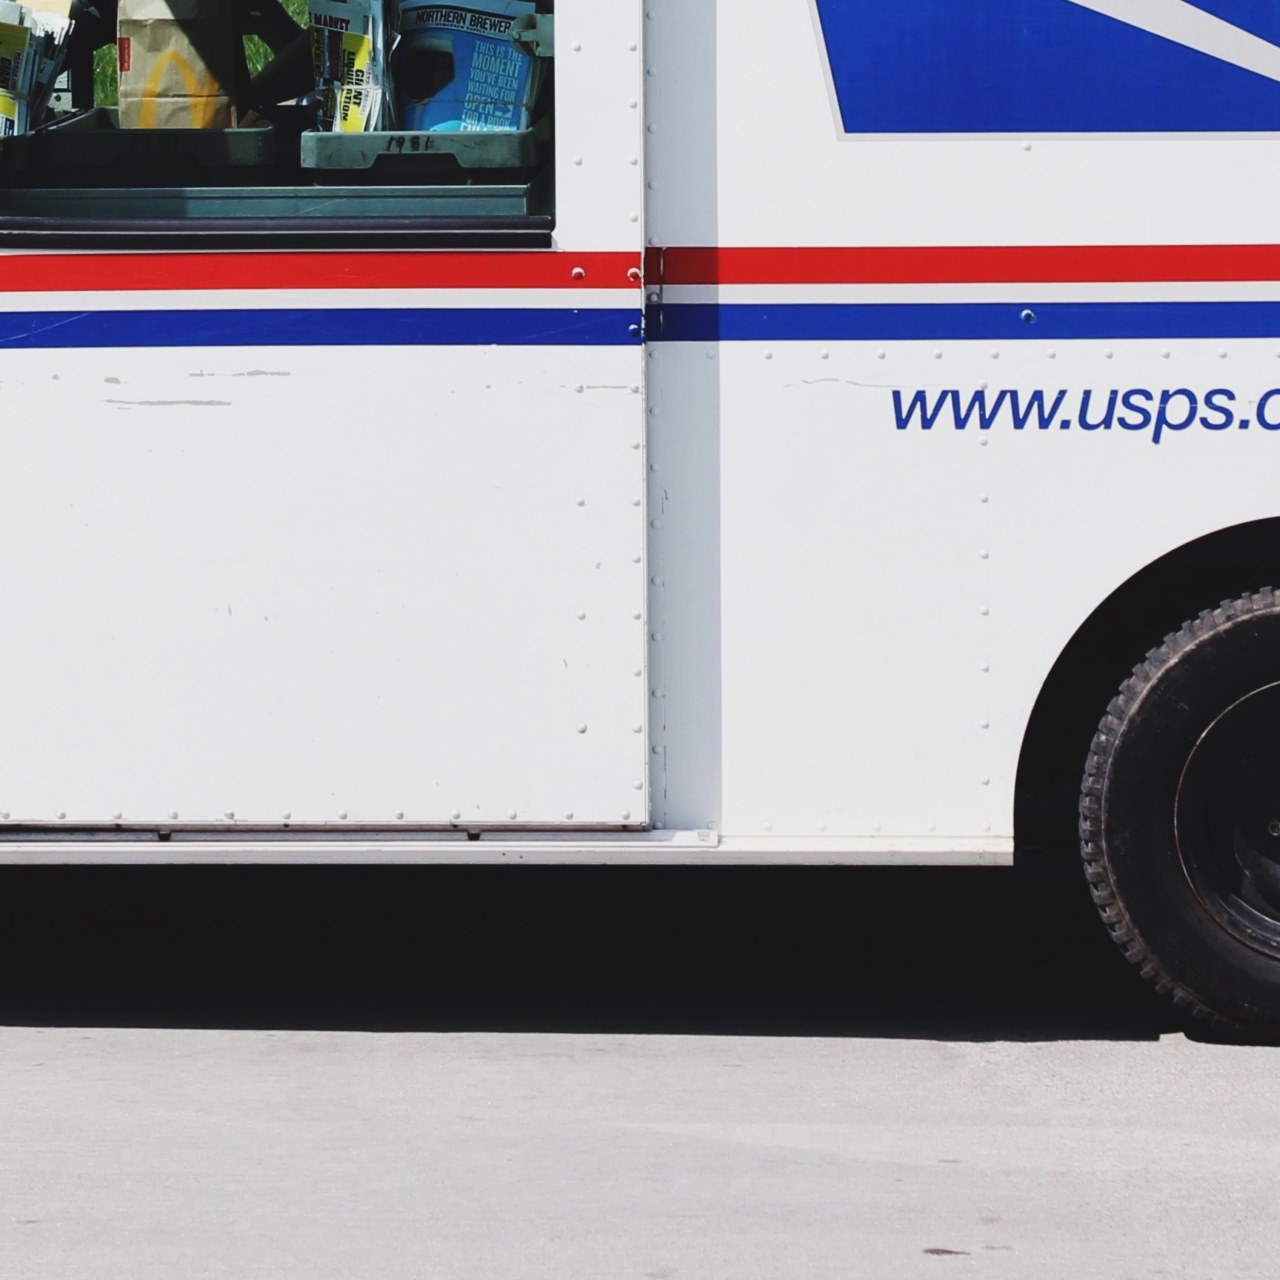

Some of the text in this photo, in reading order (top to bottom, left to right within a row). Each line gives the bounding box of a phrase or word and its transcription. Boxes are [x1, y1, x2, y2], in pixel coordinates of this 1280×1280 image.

[416, 9, 512, 34] NORTHERN BREWER
[475, 40, 494, 56] THIS
[496, 45, 505, 57] IS
[472, 53, 522, 76] MOMENT
[470, 69, 518, 90] YOU'VE BEEN
[467, 81, 516, 102] WAITING FOR
[464, 93, 495, 114] OPEN
[462, 109, 478, 124] FOR
[479, 115, 486, 127] A
